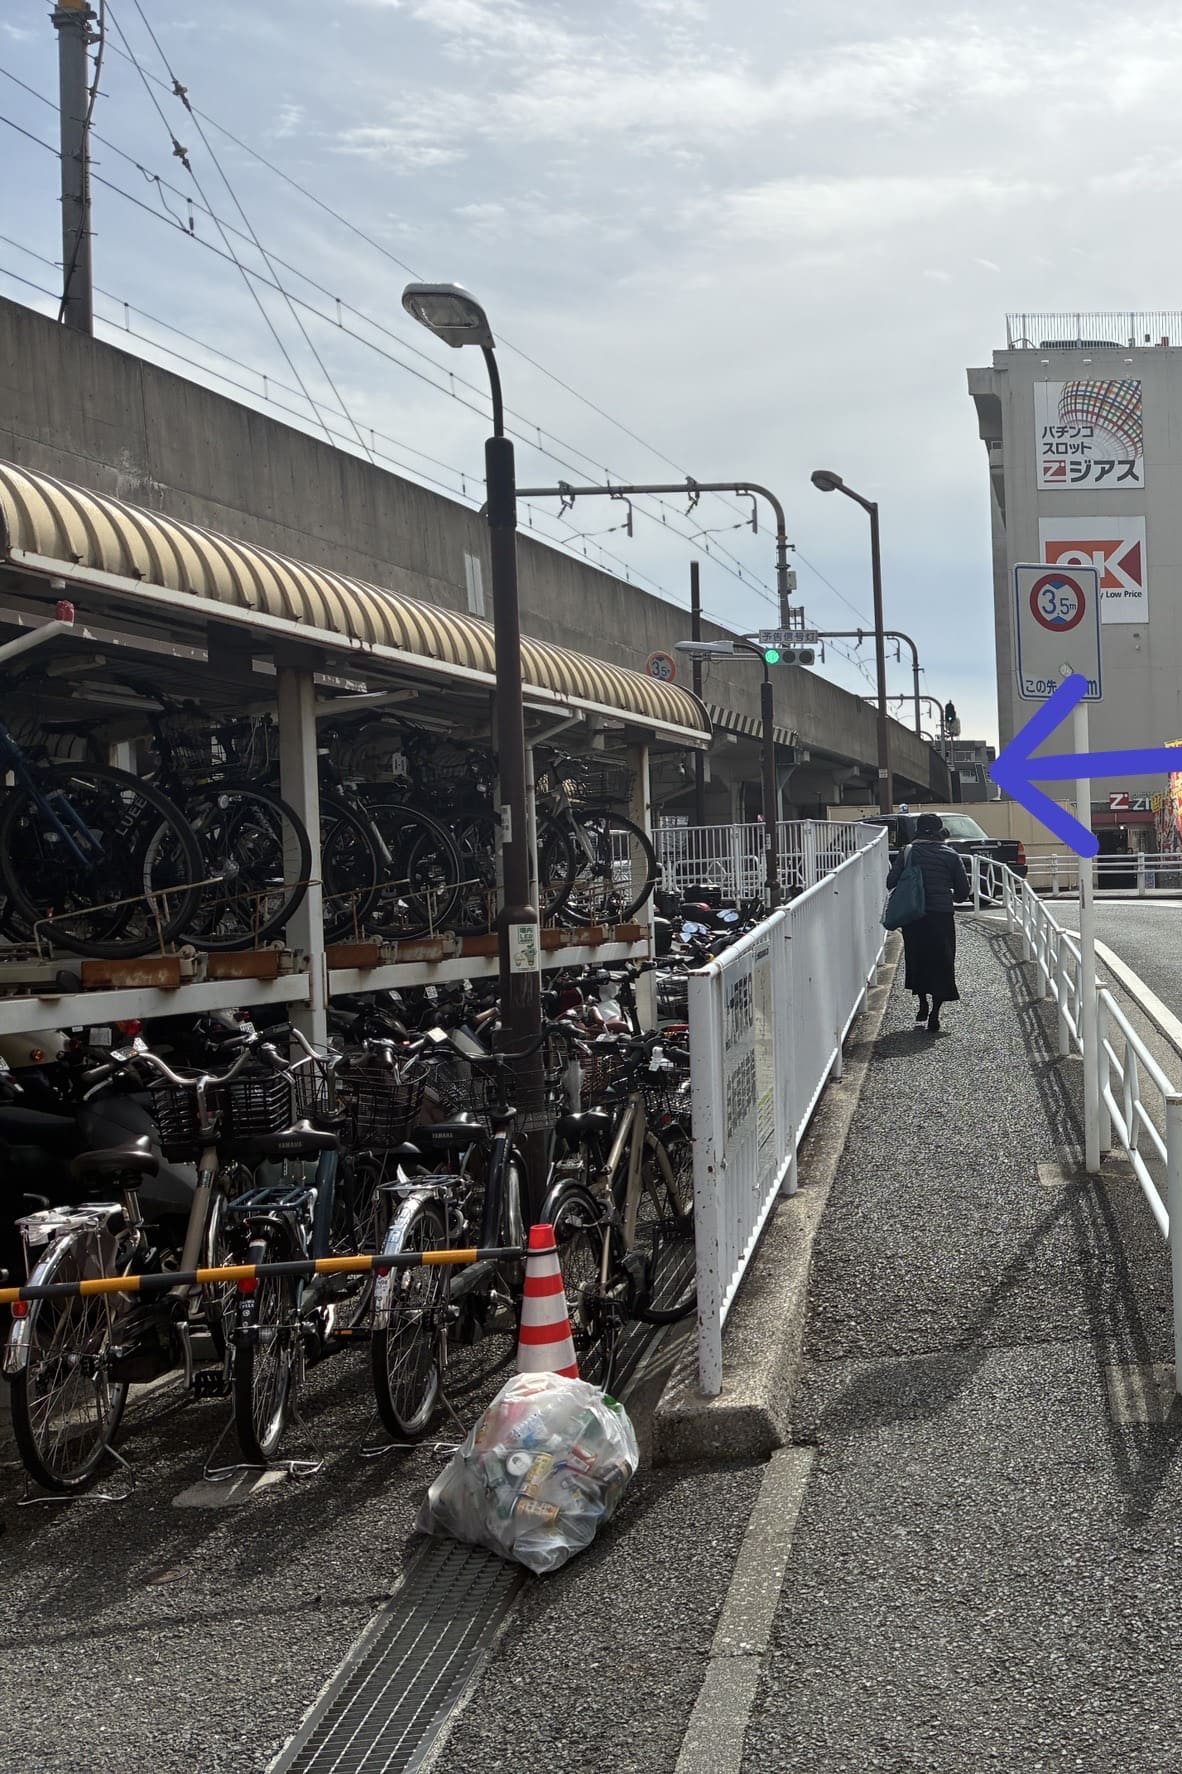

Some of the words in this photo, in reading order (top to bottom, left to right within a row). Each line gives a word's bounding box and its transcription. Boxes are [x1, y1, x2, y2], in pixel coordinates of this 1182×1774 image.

[1042, 426, 1094, 440] パチンコ
[1042, 441, 1093, 455] スロット
[1069, 459, 1140, 483] ジアス
[1105, 590, 1122, 599] Low
[1124, 590, 1143, 598] Price
[762, 631, 815, 642] 予告信号灯
